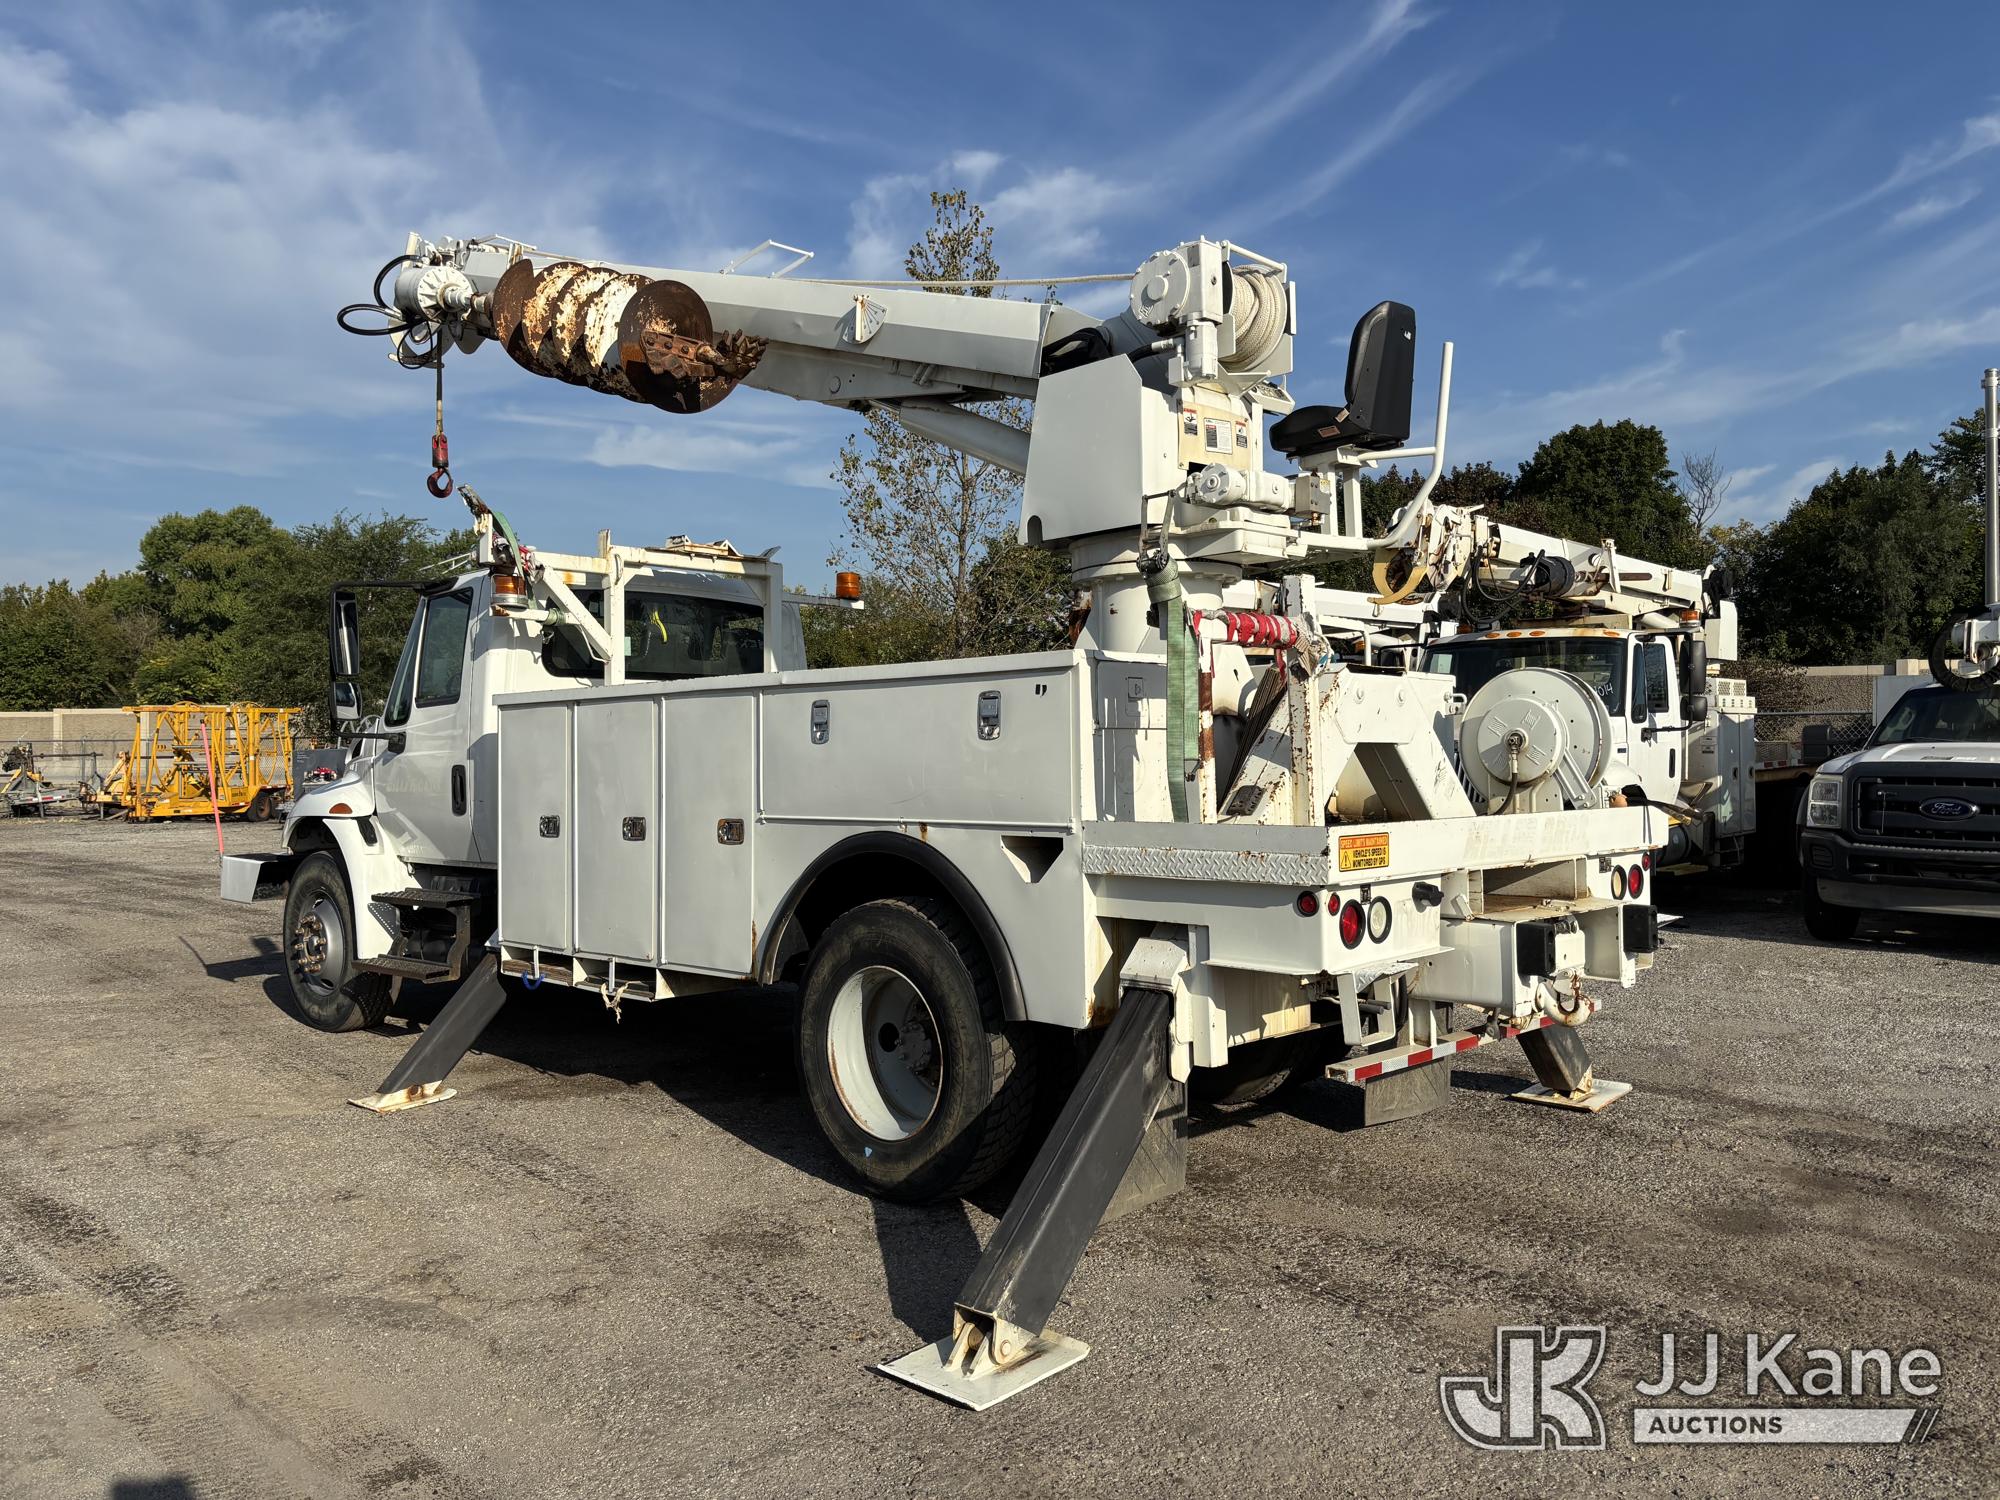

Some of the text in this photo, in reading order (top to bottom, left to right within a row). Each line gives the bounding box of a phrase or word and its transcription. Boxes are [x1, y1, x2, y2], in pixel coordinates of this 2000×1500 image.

[1931, 802, 1962, 815] Ford
[1341, 839, 1353, 849] SPEED
[1353, 848, 1371, 858] VEHICLE'S
[1371, 847, 1382, 857] SPEED
[1353, 858, 1373, 868] MONITORED
